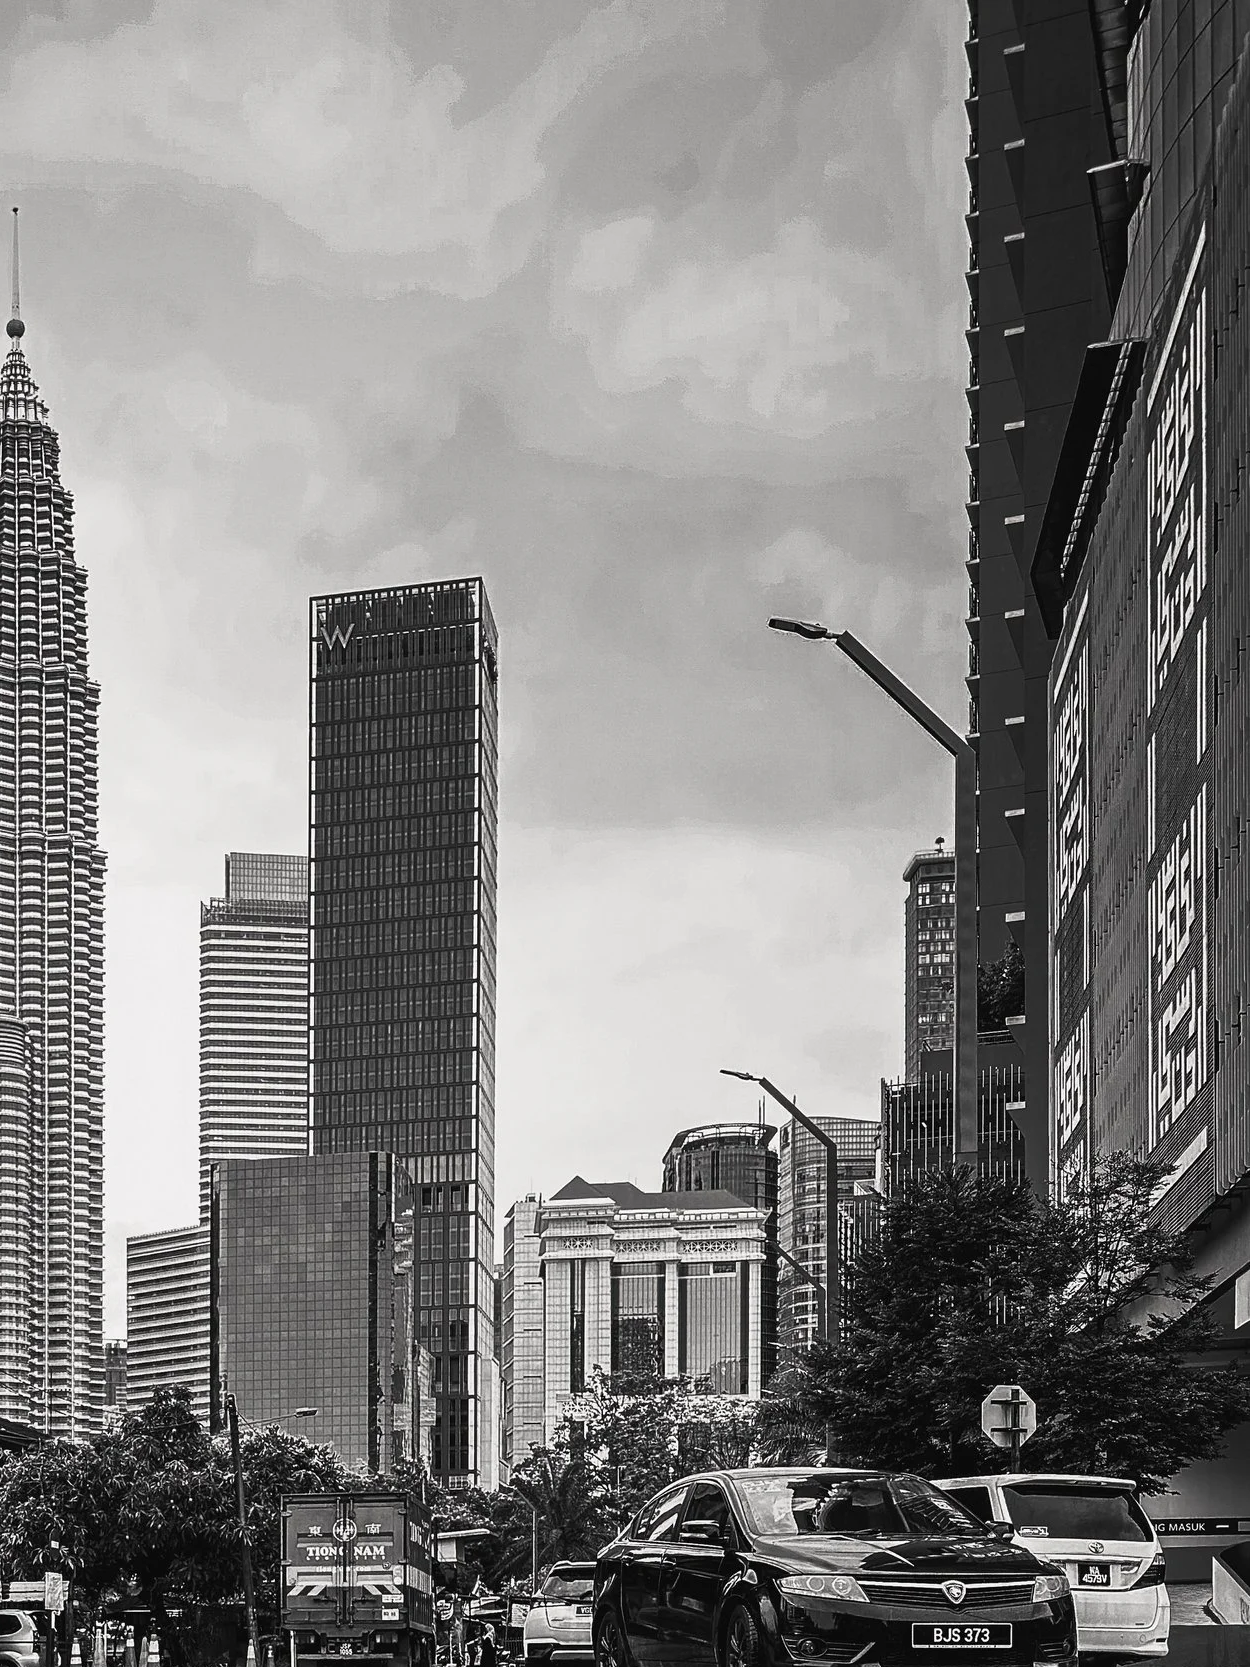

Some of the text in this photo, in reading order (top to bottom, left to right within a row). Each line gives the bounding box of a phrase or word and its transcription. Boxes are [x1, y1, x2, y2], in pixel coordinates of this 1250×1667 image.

[320, 623, 356, 651] W
[1168, 1523, 1206, 1532] MASUK
[353, 1545, 386, 1556] NAM
[933, 1627, 991, 1643] BJS 373
